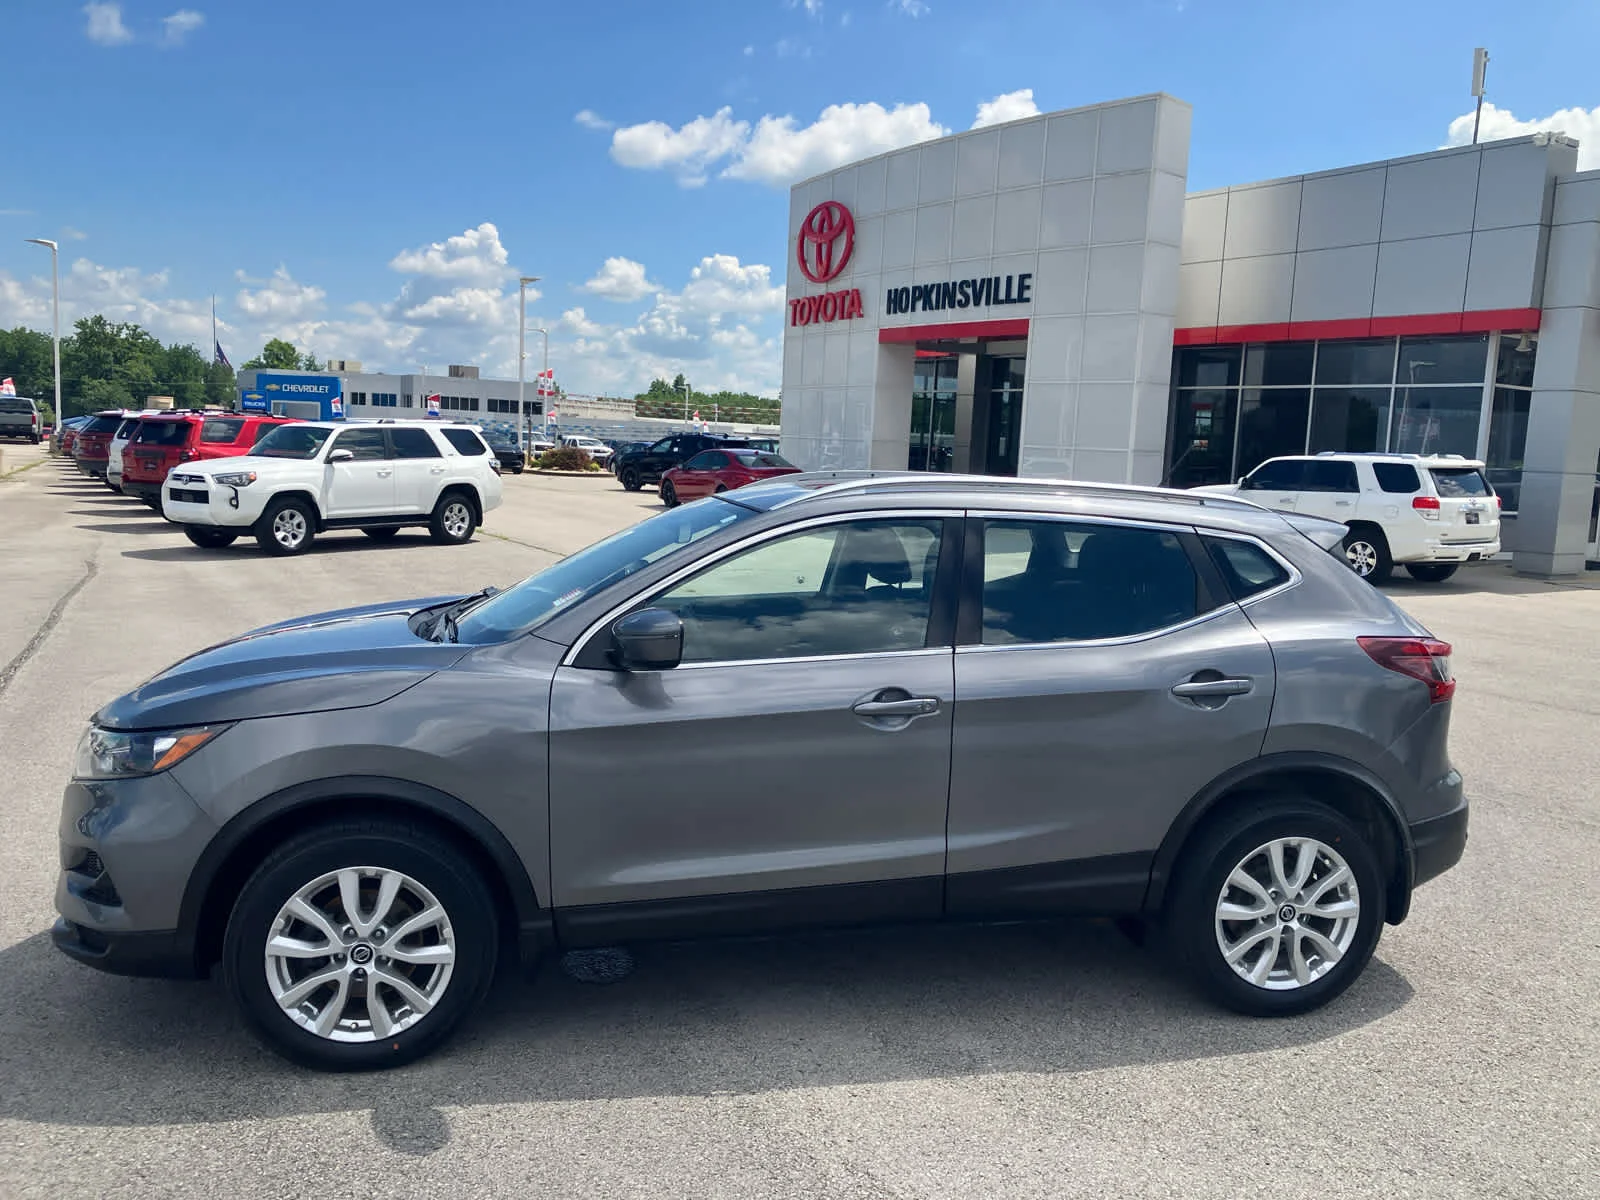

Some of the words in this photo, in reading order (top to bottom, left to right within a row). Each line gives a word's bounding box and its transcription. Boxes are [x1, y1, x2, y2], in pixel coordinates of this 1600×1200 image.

[789, 288, 864, 327] TOYOTA
[886, 273, 1033, 315] HOPKINSVILLE
[282, 383, 329, 393] CHEVROLET
